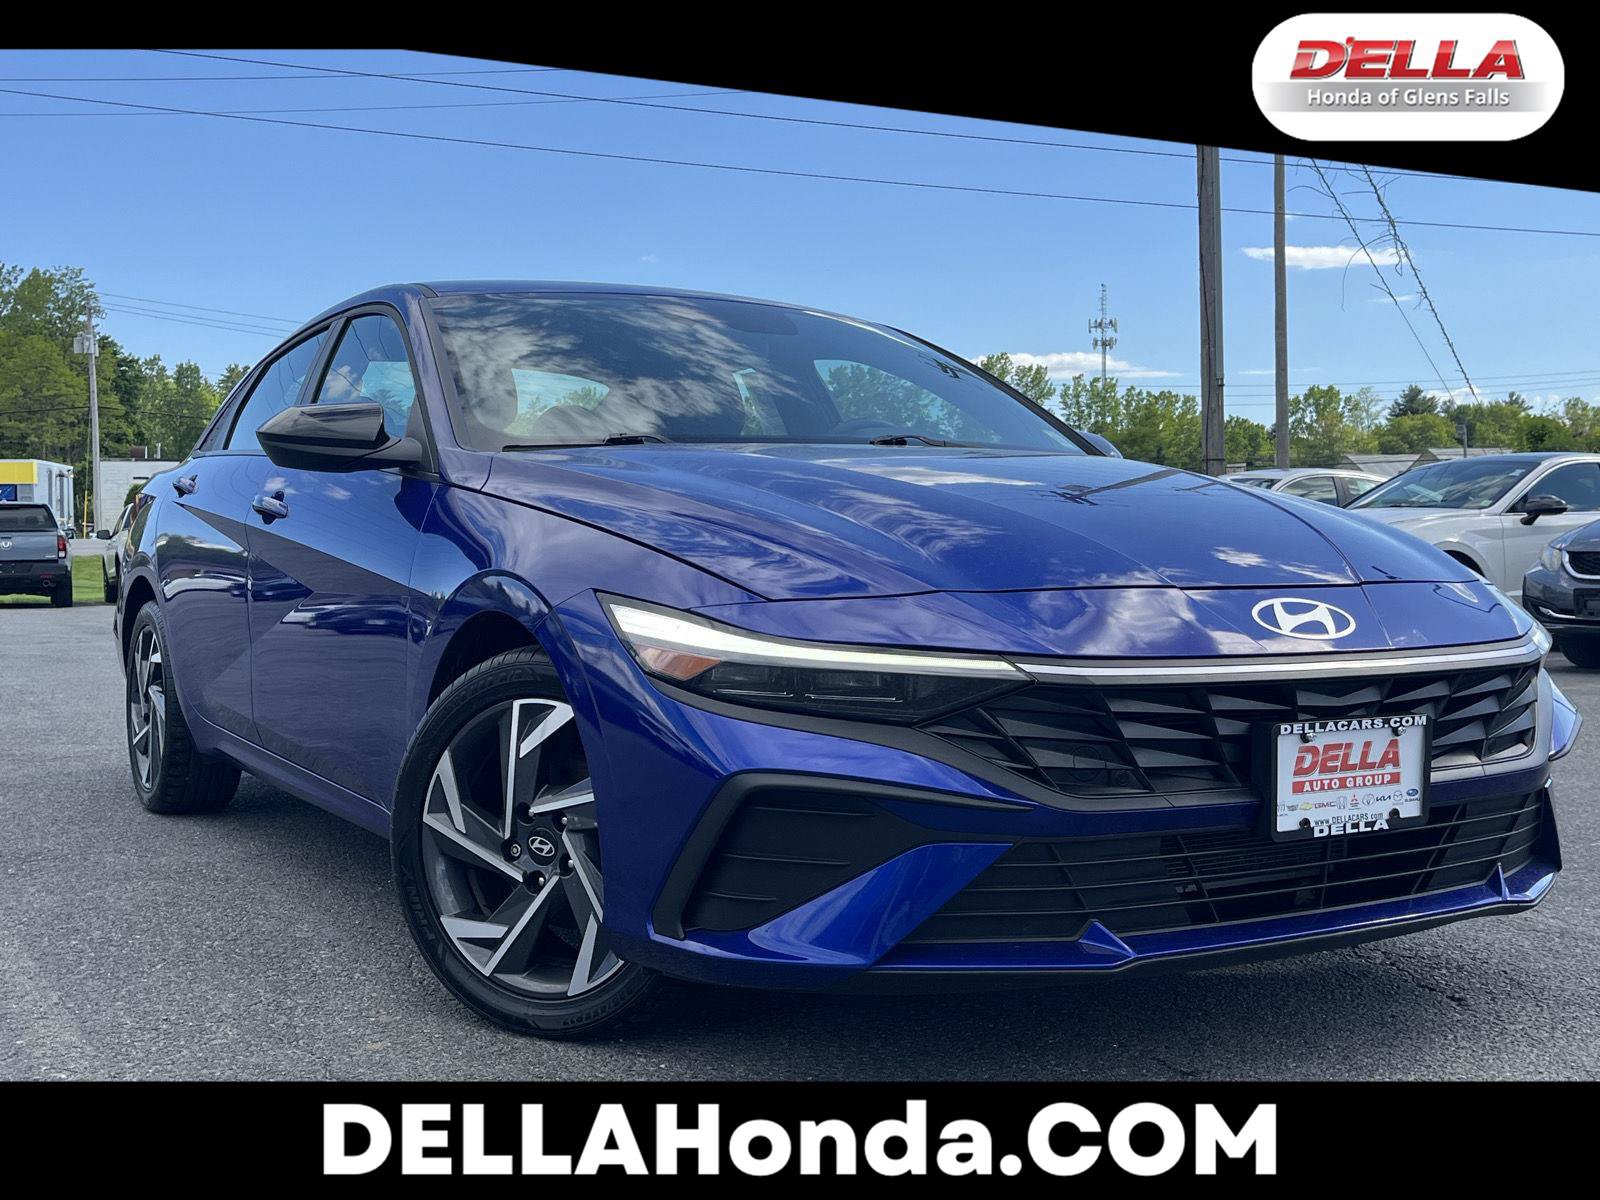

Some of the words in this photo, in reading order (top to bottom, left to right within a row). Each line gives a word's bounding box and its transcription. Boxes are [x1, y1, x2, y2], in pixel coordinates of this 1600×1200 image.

[1280, 715, 1427, 735] DELLACARS.COM
[1303, 779, 1340, 792] AUTO
[1346, 774, 1391, 788] GROUP
[1314, 819, 1390, 838] DELLA
